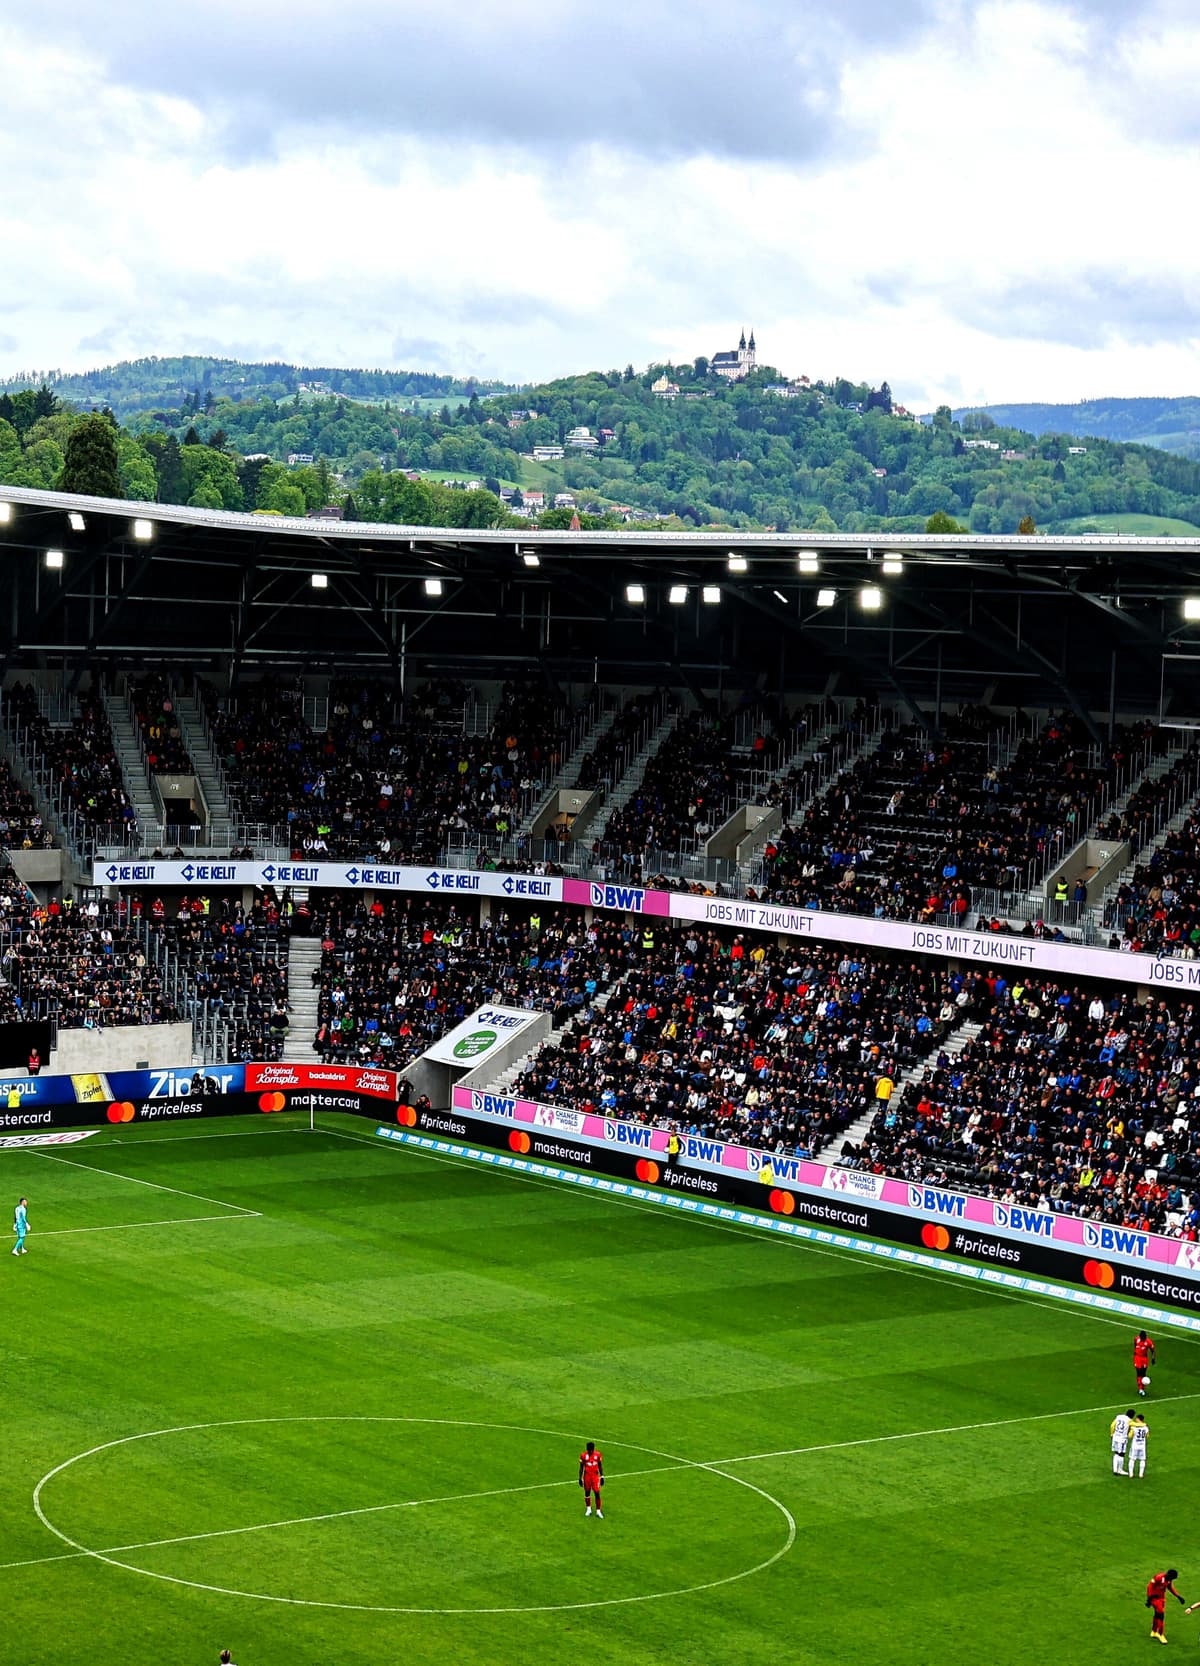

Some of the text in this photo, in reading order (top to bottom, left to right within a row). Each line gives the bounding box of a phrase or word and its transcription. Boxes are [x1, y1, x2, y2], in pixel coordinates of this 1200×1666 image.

[119, 866, 155, 880] KE KELIT
[196, 866, 236, 880] KE KELIT
[278, 867, 319, 882] KE KELIT
[361, 869, 401, 885] KE KELIT
[441, 873, 480, 890] KE KELIT
[515, 879, 551, 896] KE KELIT
[605, 886, 644, 911] BWT
[705, 903, 813, 932] JOBS MIT ZUKUNFT
[912, 931, 1035, 963] JOBS MIT ZUKUNFT
[1149, 962, 1184, 983] JOBS
[255, 1073, 300, 1085] Kornspitz
[264, 1066, 294, 1075] Original
[362, 1071, 387, 1082] Original
[82, 1084, 103, 1099] Zipfer
[290, 1093, 360, 1109] mastercard
[484, 1096, 515, 1119] BWT
[141, 1102, 202, 1119] #priceless
[555, 1110, 578, 1121] CHANGE
[420, 1112, 467, 1135] #priceless
[560, 1118, 578, 1127] WORLD
[617, 1124, 651, 1148] BWT
[534, 1139, 591, 1164] mastercard
[687, 1138, 723, 1163] BWT
[663, 1167, 718, 1193] #priceless
[848, 1173, 876, 1186] CHANGE
[854, 1183, 876, 1192] WORLD
[924, 1189, 965, 1217] BWT
[799, 1201, 869, 1228] mastercard
[1010, 1208, 1054, 1236] BWT
[955, 1233, 1021, 1263] #priceless
[1101, 1228, 1147, 1256] BWT
[1116, 1420, 1125, 1430] 23
[1136, 1429, 1145, 1439] 30
